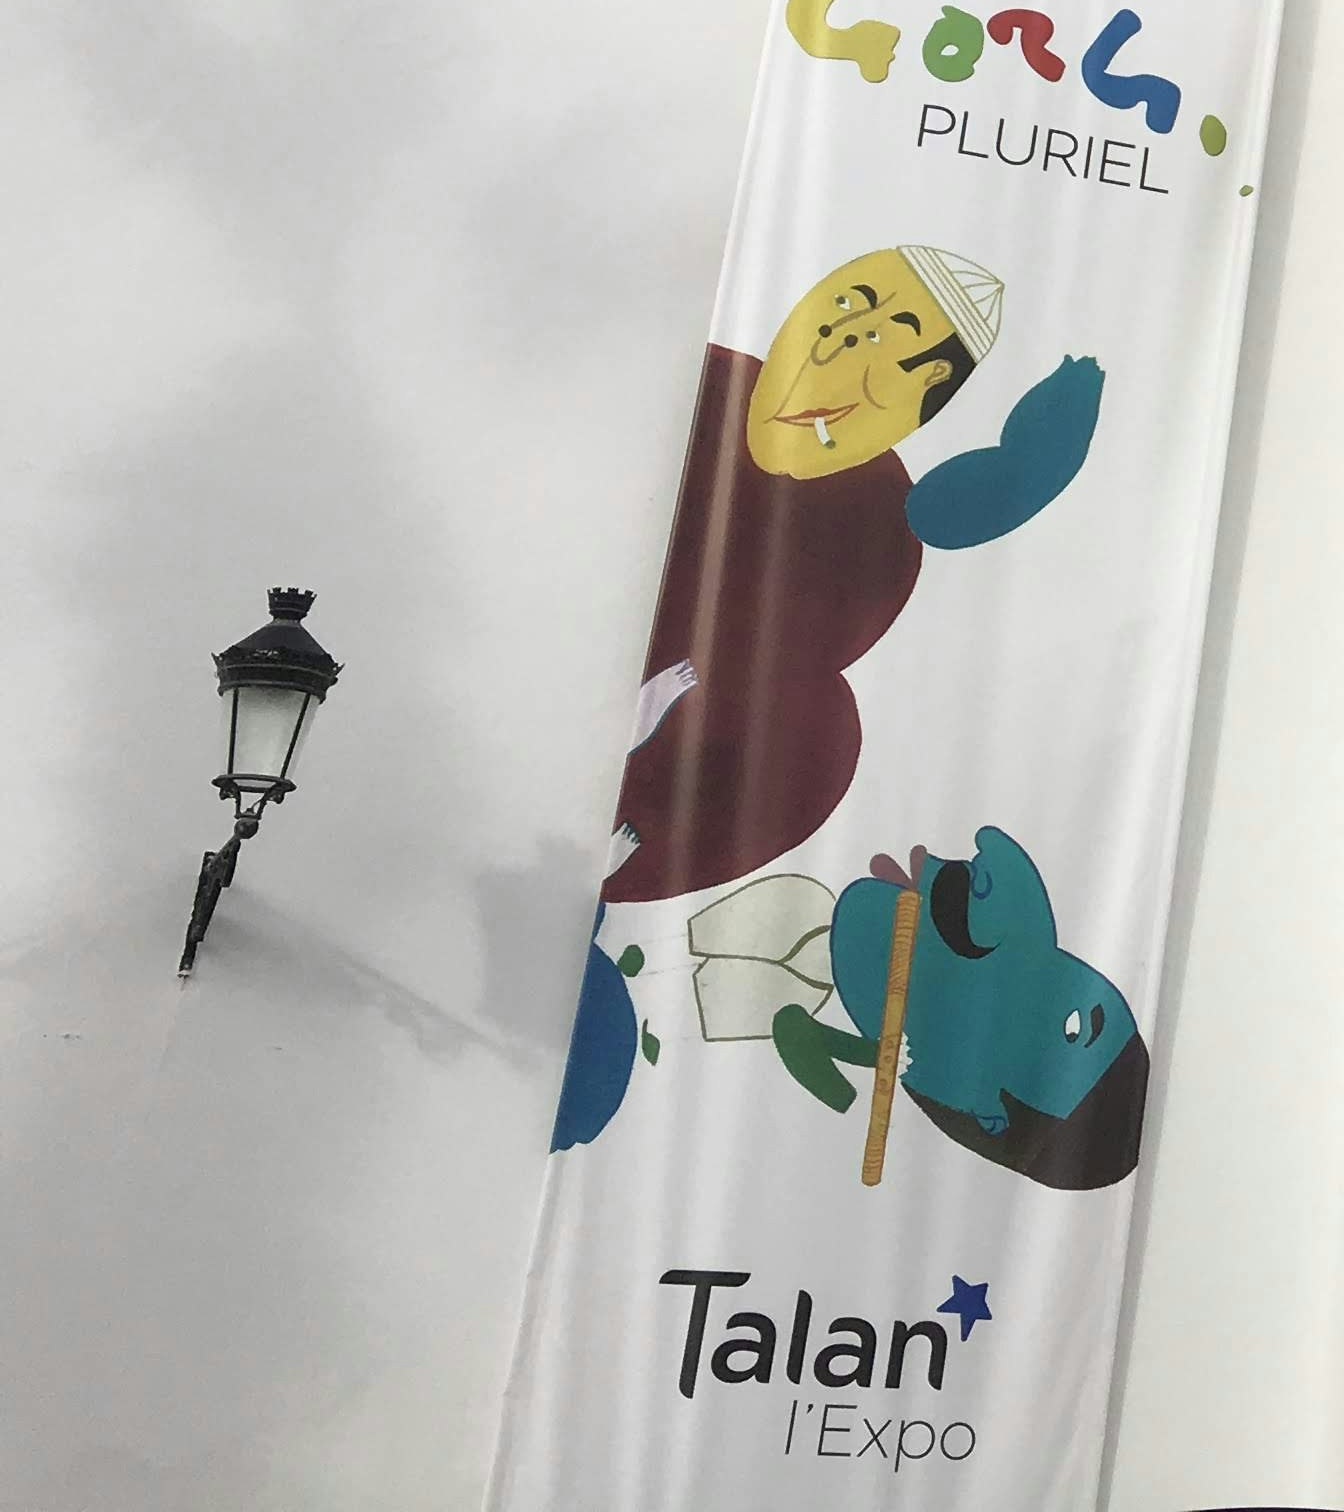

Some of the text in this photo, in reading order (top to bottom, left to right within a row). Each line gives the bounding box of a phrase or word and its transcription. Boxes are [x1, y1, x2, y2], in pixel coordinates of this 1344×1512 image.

[916, 103, 1169, 195] PLURIEL
[658, 1269, 949, 1400] Talan
[784, 1399, 977, 1473] l'Expo
